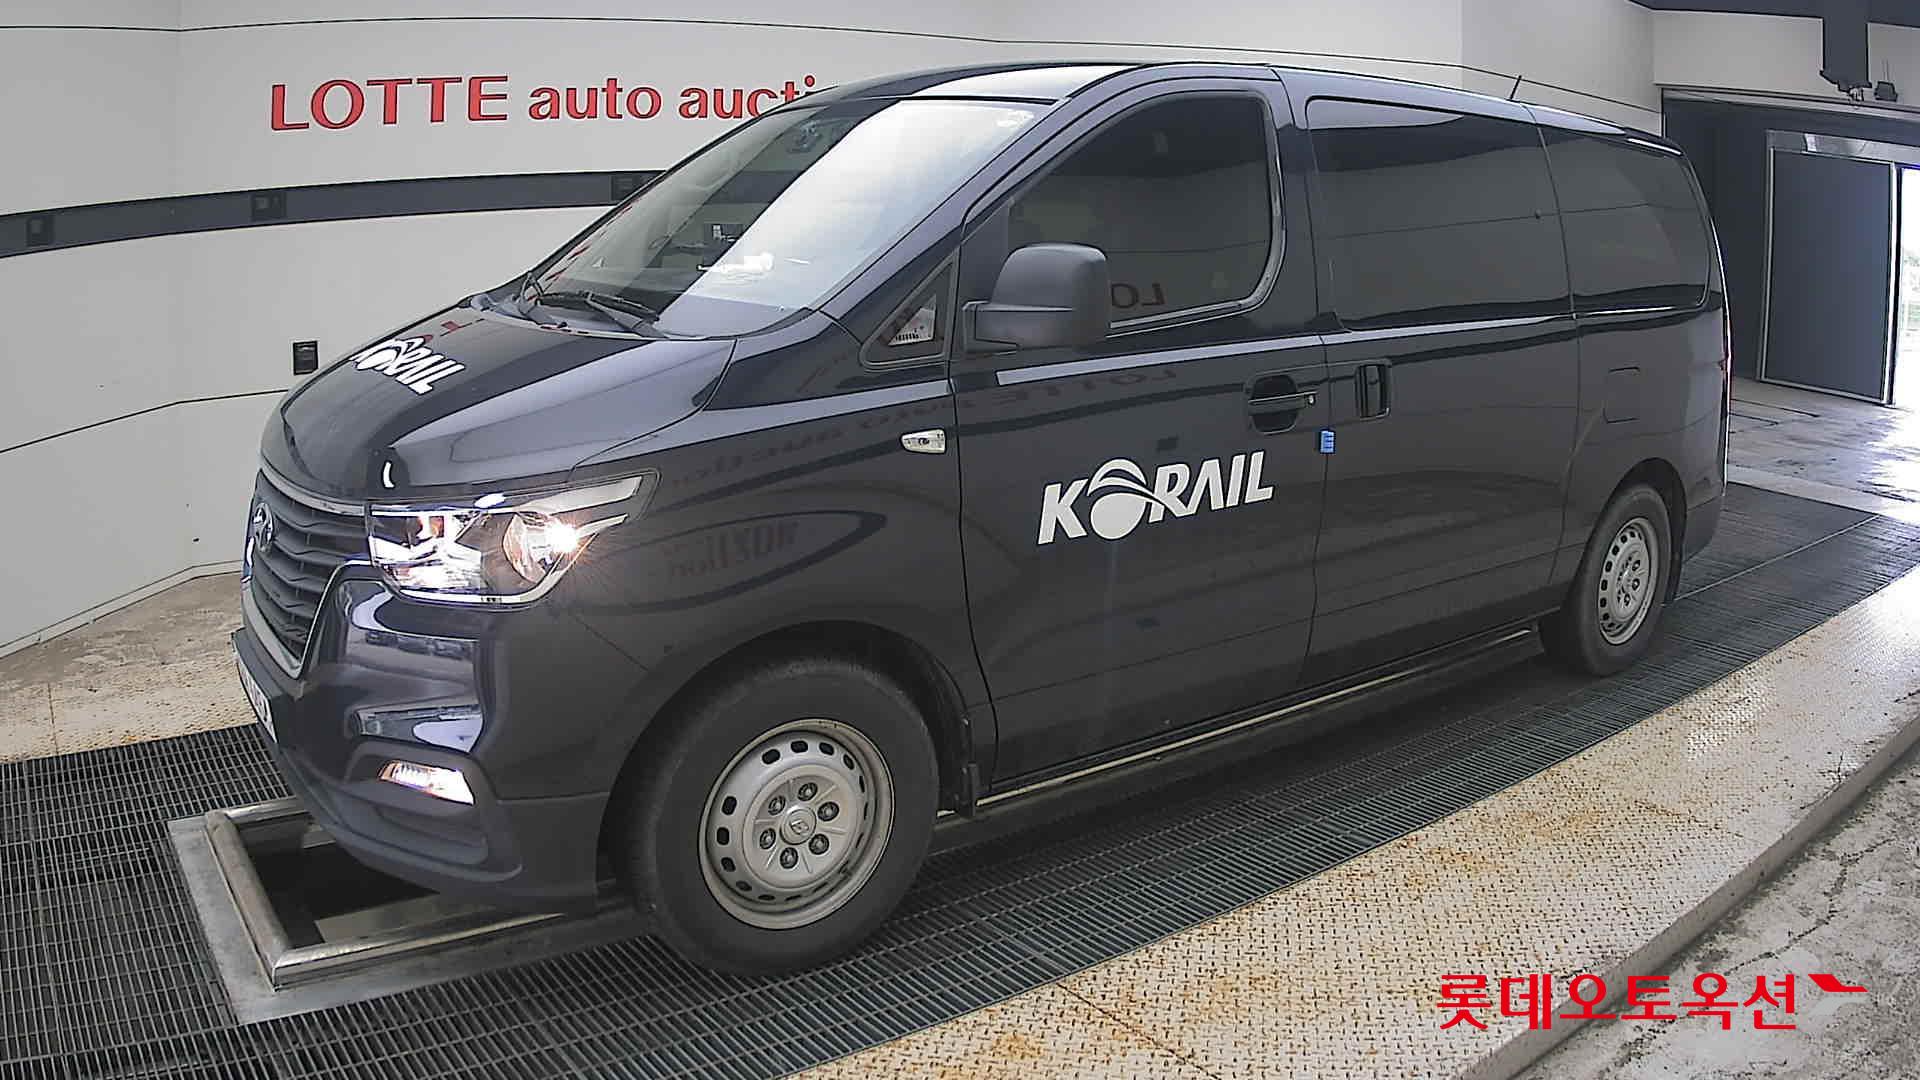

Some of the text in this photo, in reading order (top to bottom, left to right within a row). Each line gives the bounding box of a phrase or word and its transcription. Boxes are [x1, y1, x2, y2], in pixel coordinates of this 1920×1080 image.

[271, 76, 508, 131] LOTTE
[528, 78, 662, 120] auto
[349, 337, 465, 395] ORAIL
[1037, 450, 1274, 545] KORAIL
